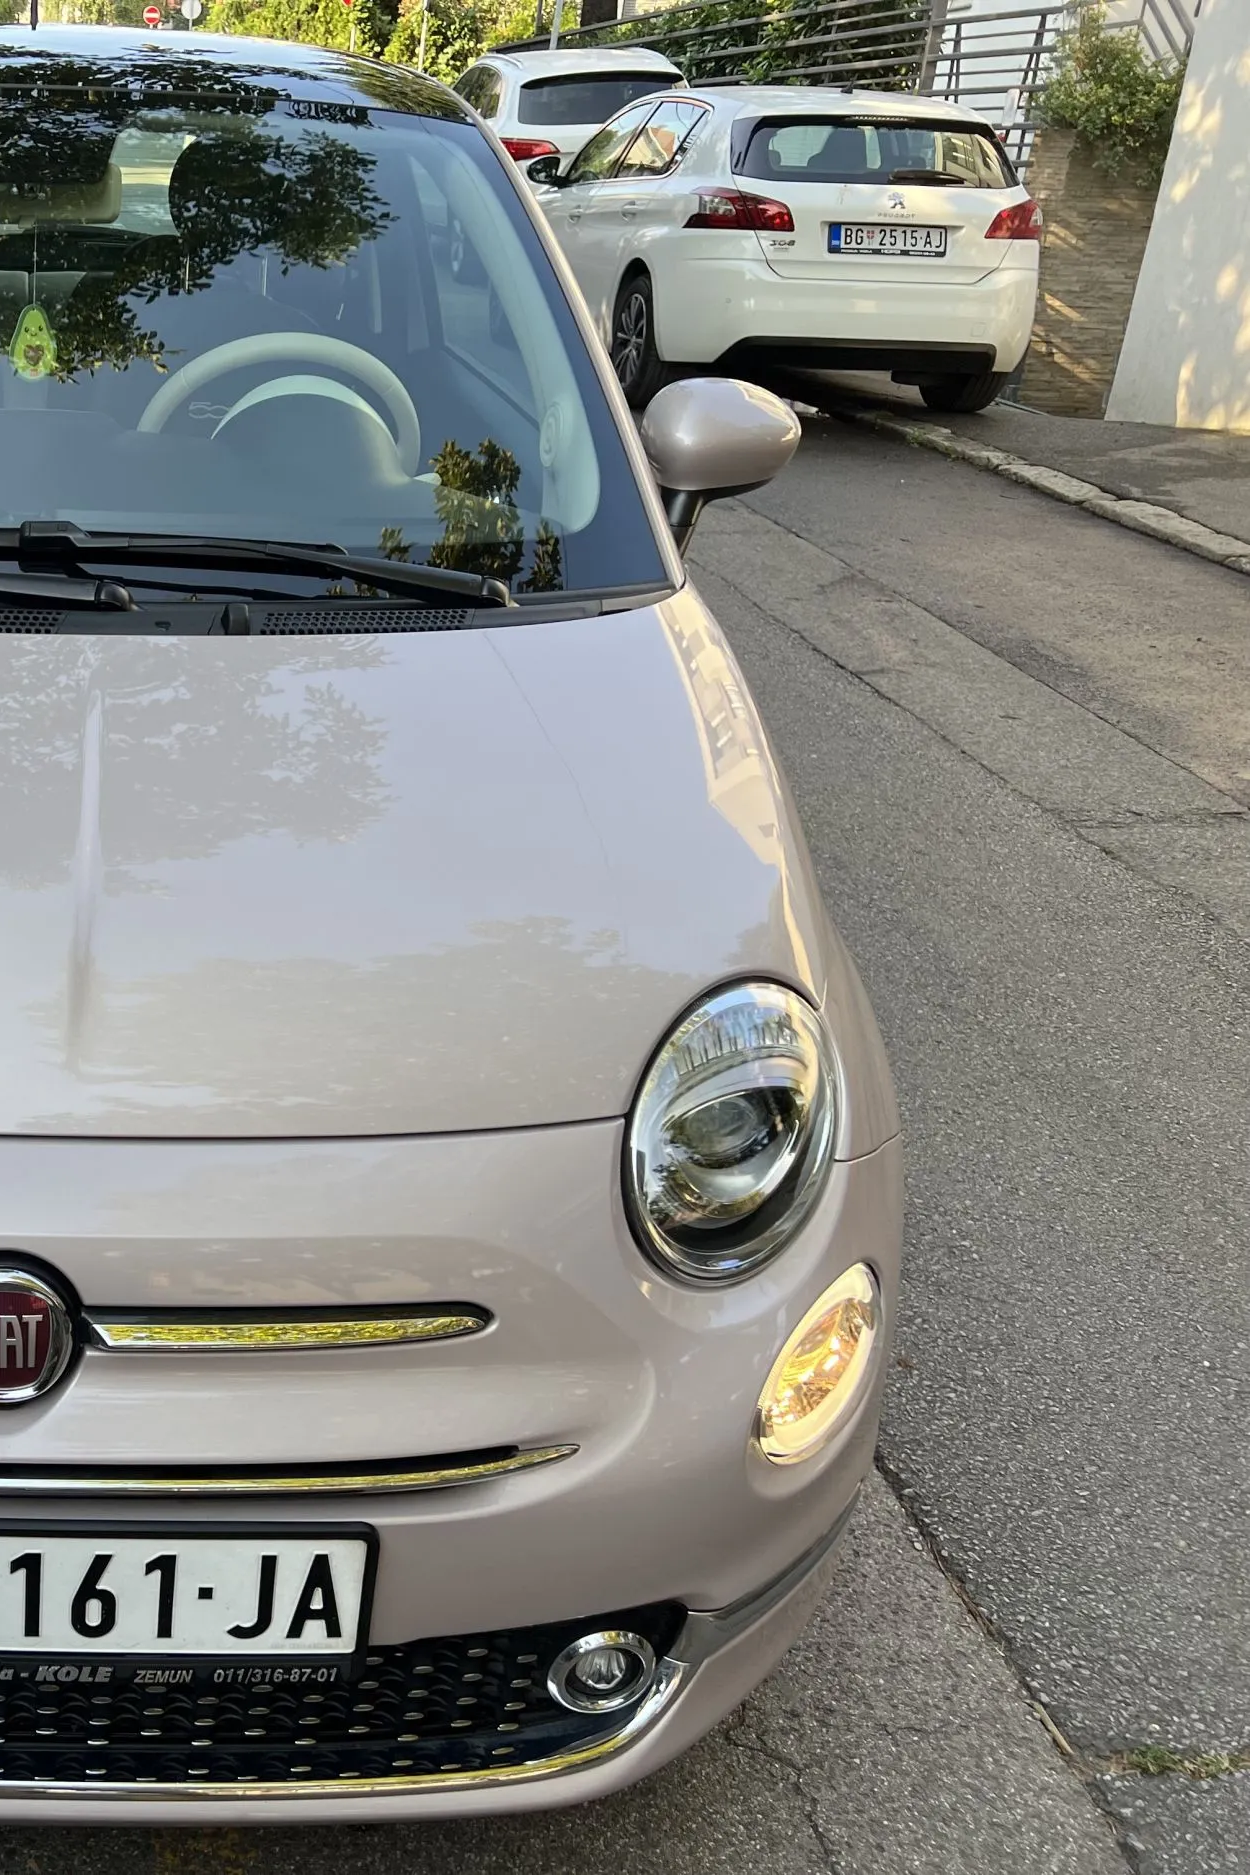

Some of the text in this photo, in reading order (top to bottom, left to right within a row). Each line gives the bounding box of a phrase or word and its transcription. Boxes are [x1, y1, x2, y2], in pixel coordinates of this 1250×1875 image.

[844, 228, 864, 245] BG
[35, 1665, 114, 1683] KOLE
[134, 1669, 193, 1684] ZEMUN
[213, 1667, 338, 1684] 011/316-87-01
